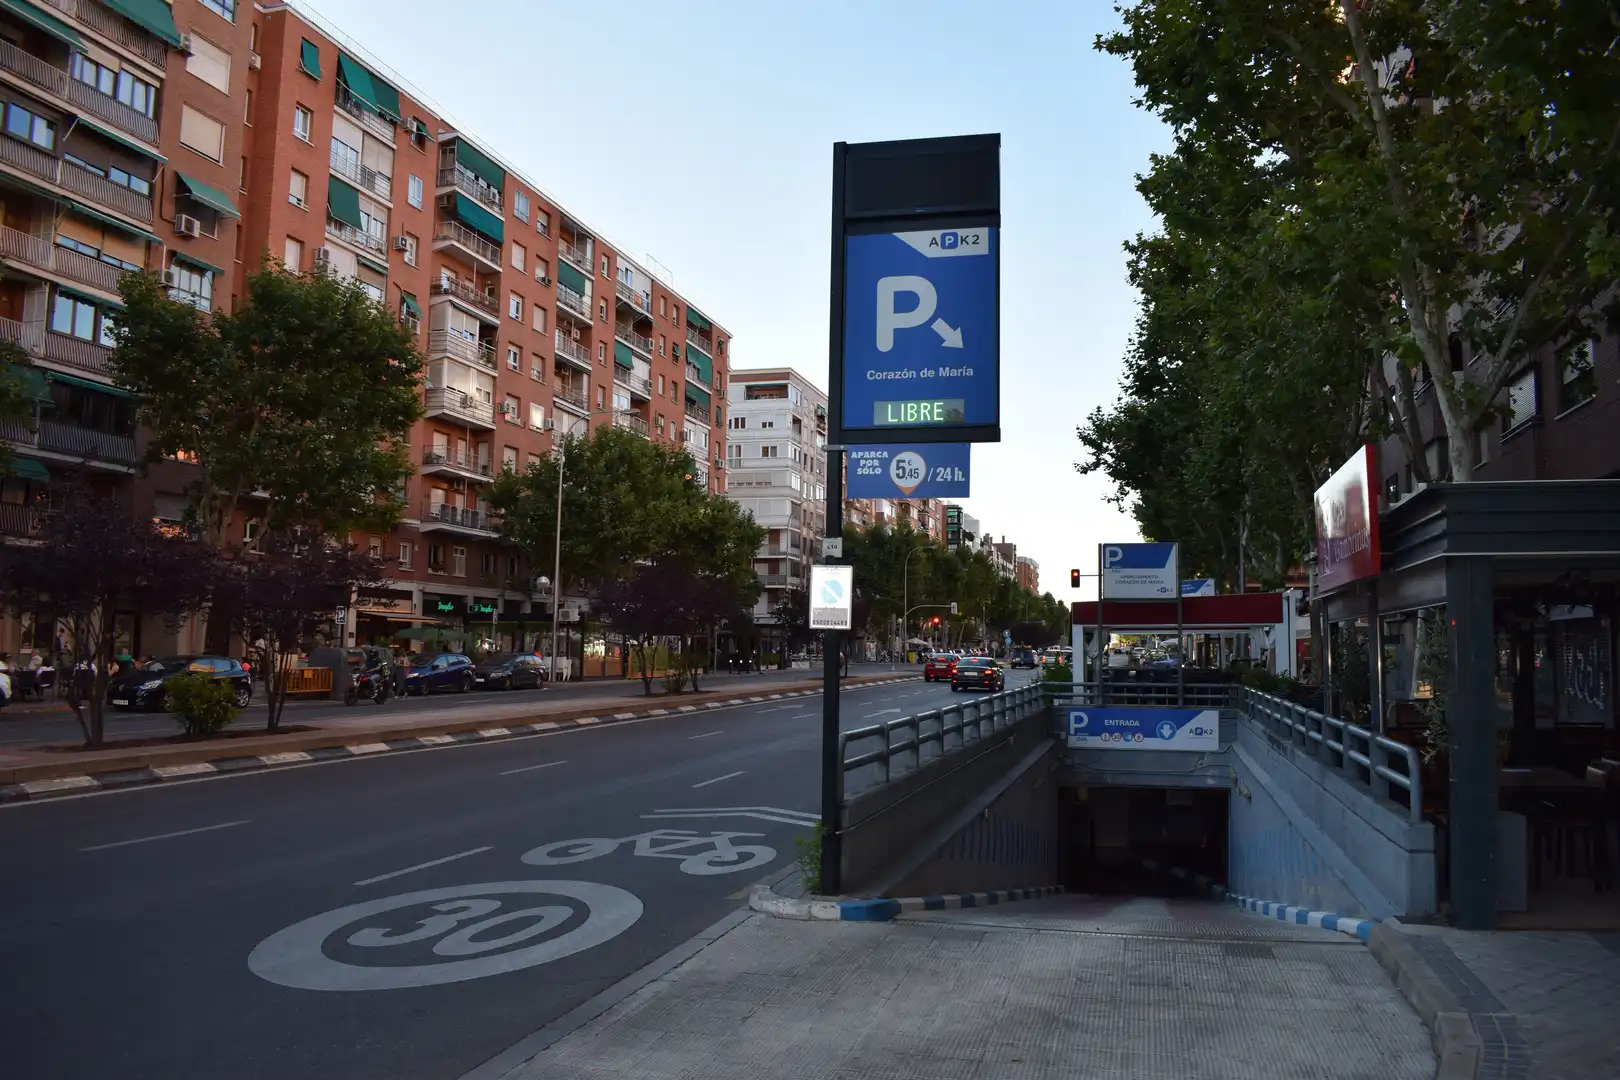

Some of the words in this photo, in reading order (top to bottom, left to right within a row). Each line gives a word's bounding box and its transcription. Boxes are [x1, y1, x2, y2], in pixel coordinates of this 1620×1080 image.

[929, 233, 980, 248] APK2
[876, 275, 938, 353] P
[866, 368, 916, 380] Corazón
[920, 368, 935, 378] de
[939, 366, 974, 377] María
[888, 402, 944, 422] LIBRE
[857, 466, 882, 474] SÓLO
[936, 467, 952, 482] 24
[1105, 546, 1123, 568] P
[1070, 711, 1089, 735] P
[346, 898, 575, 956] 30
